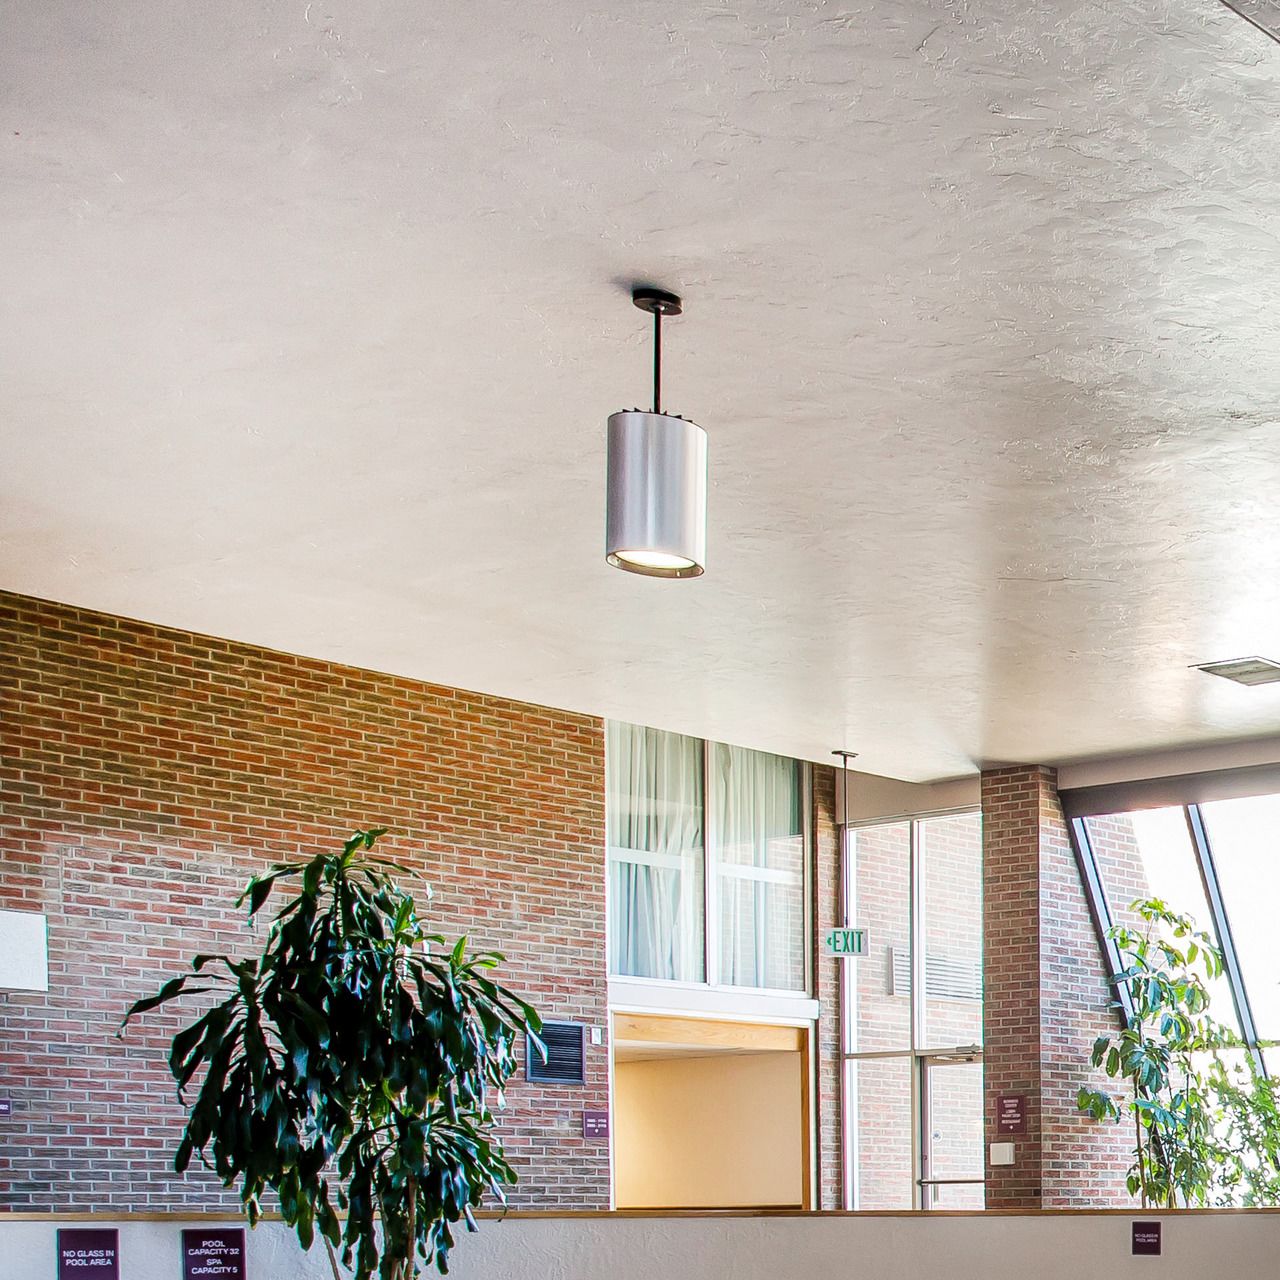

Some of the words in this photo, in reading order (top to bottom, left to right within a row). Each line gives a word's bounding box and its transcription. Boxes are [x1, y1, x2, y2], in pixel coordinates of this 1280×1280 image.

[832, 931, 863, 953] EXIT
[202, 1240, 226, 1248] POOL
[206, 1258, 223, 1266] SPA
